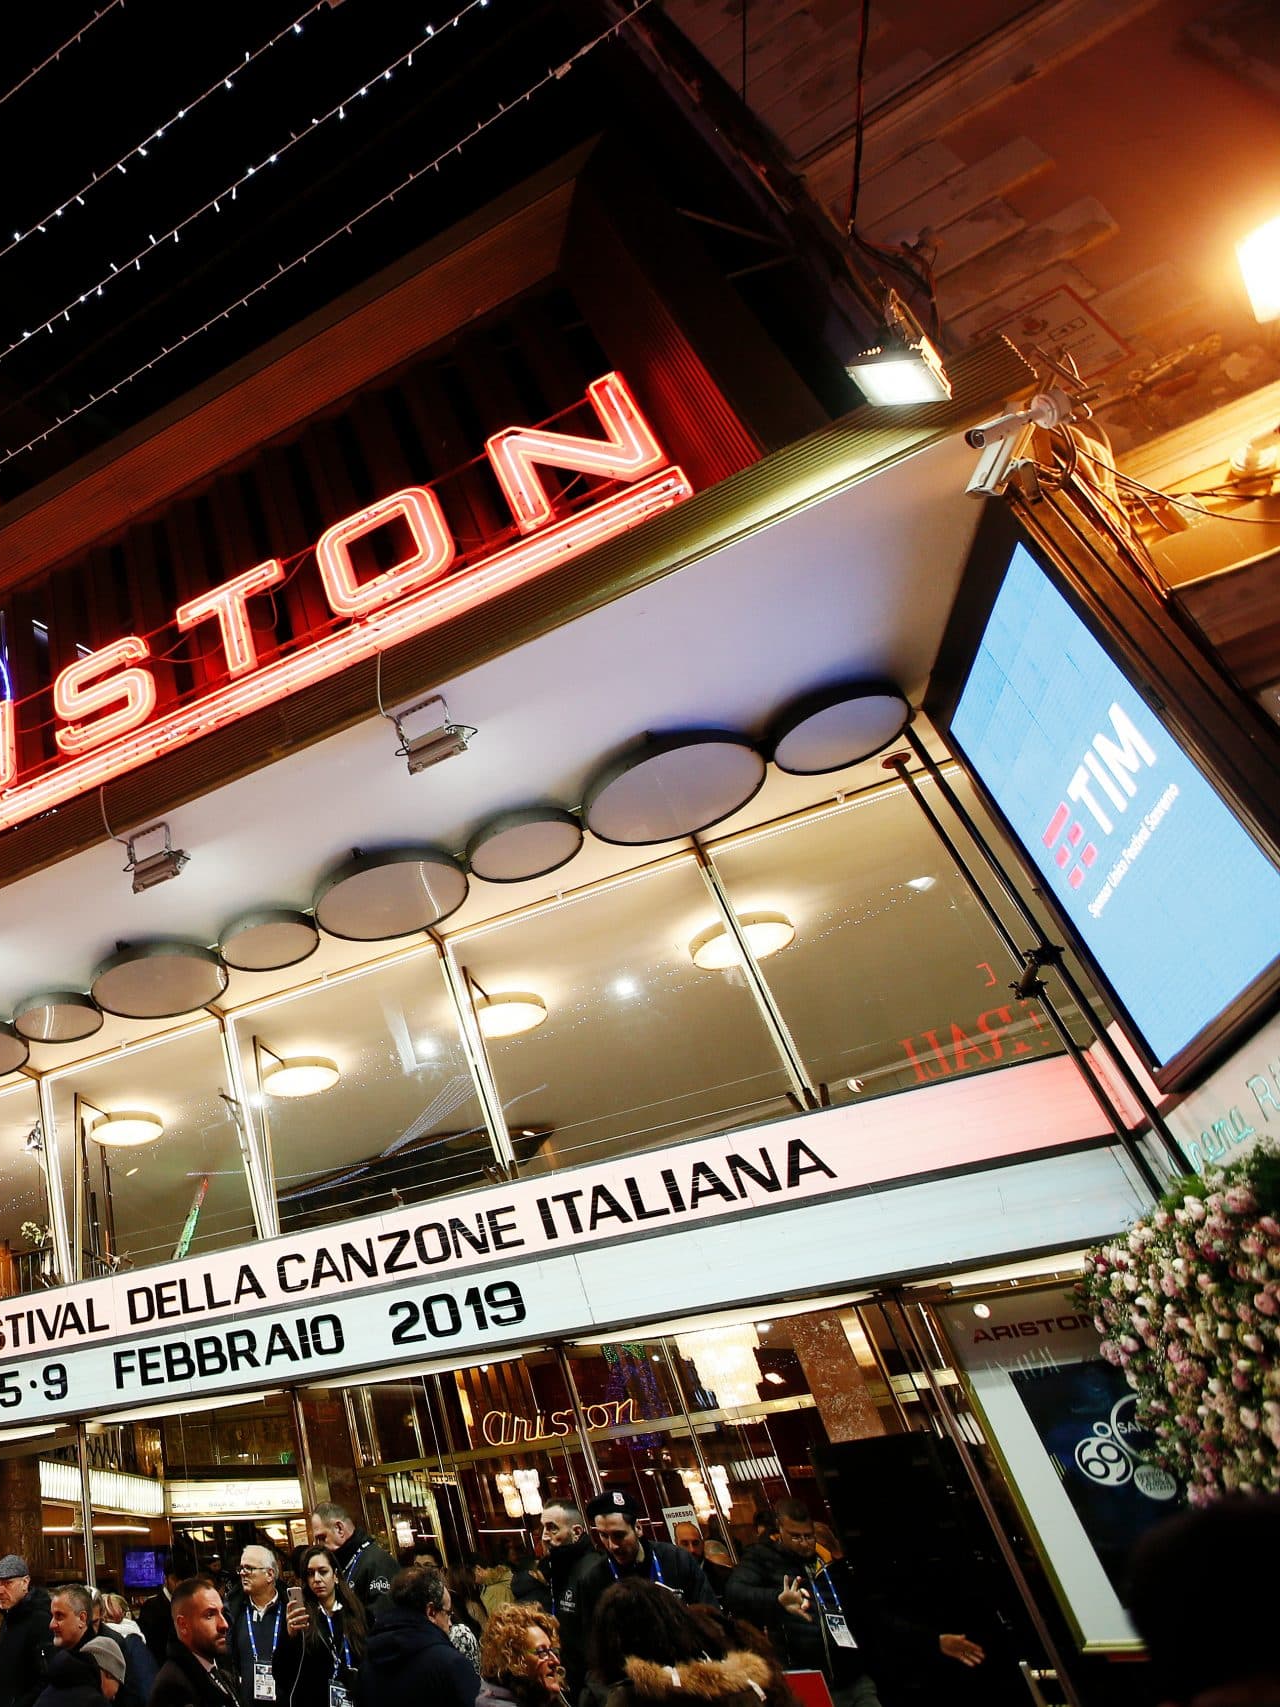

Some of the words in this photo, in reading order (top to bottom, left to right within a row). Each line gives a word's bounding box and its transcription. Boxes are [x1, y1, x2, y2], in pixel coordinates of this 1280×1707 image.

[1067, 702, 1157, 838] TIM
[127, 1263, 267, 1325] DELLA
[276, 1205, 526, 1294] CANZONE
[536, 1138, 838, 1241] ITALIANA
[114, 1311, 345, 1389] FEBBRAIO
[389, 1280, 527, 1346] 2019
